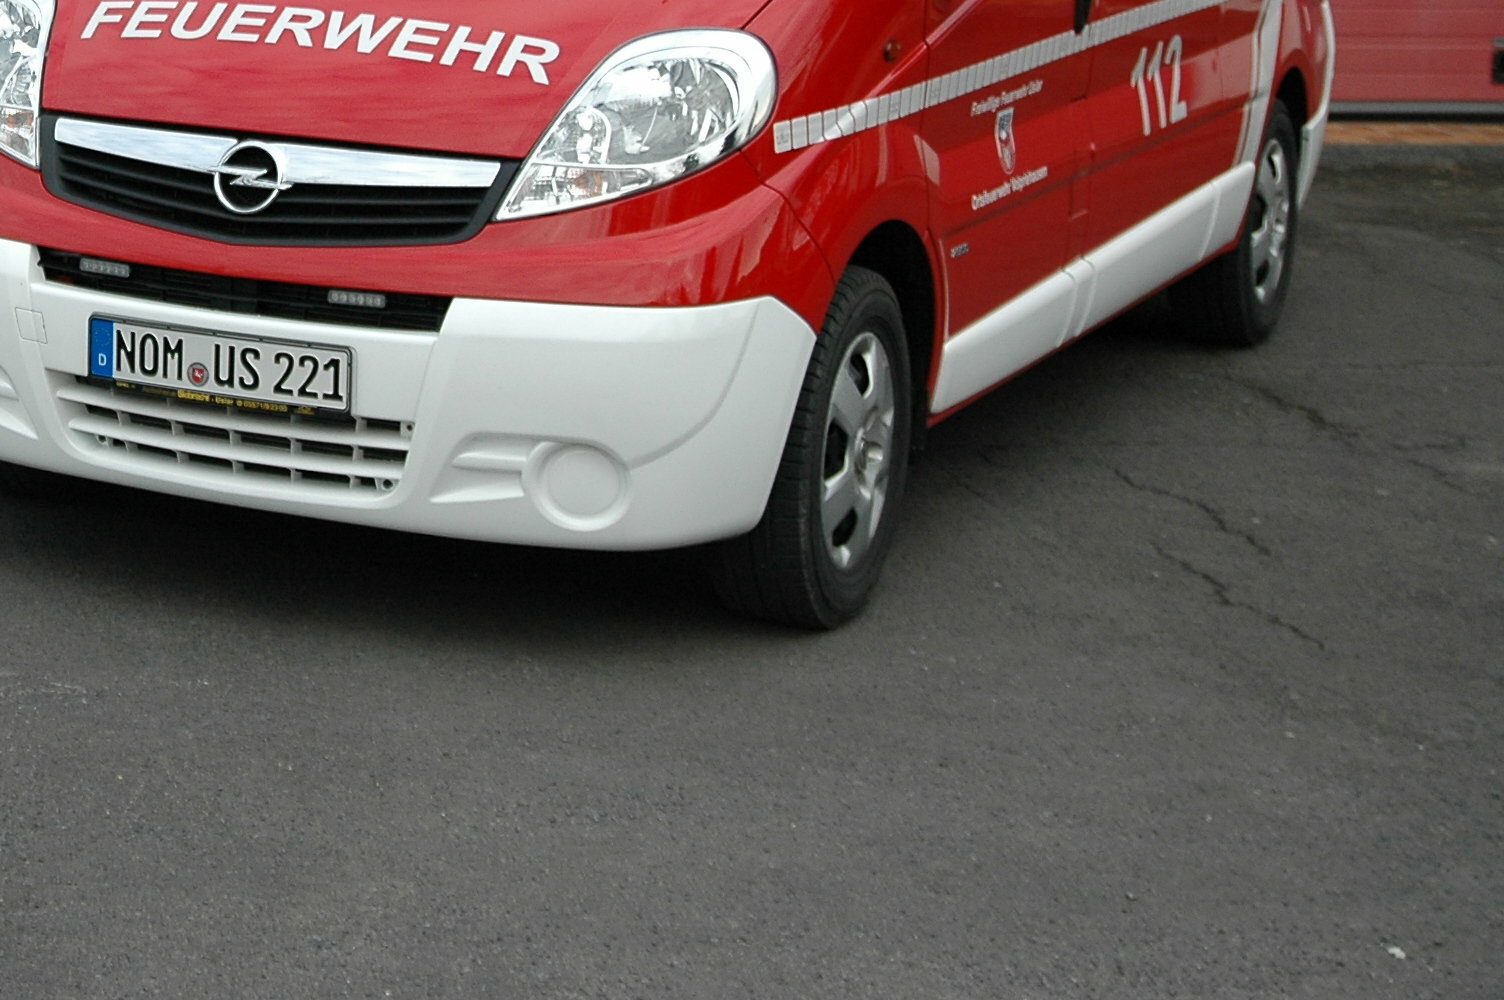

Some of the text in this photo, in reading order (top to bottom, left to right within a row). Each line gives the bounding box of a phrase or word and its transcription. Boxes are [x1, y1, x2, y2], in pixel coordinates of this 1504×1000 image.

[80, 0, 561, 86] FEUERWEHR
[1129, 33, 1188, 136] 112
[97, 352, 108, 367] D
[115, 328, 185, 381] NOM
[213, 343, 262, 391] US
[272, 351, 345, 403] 221
